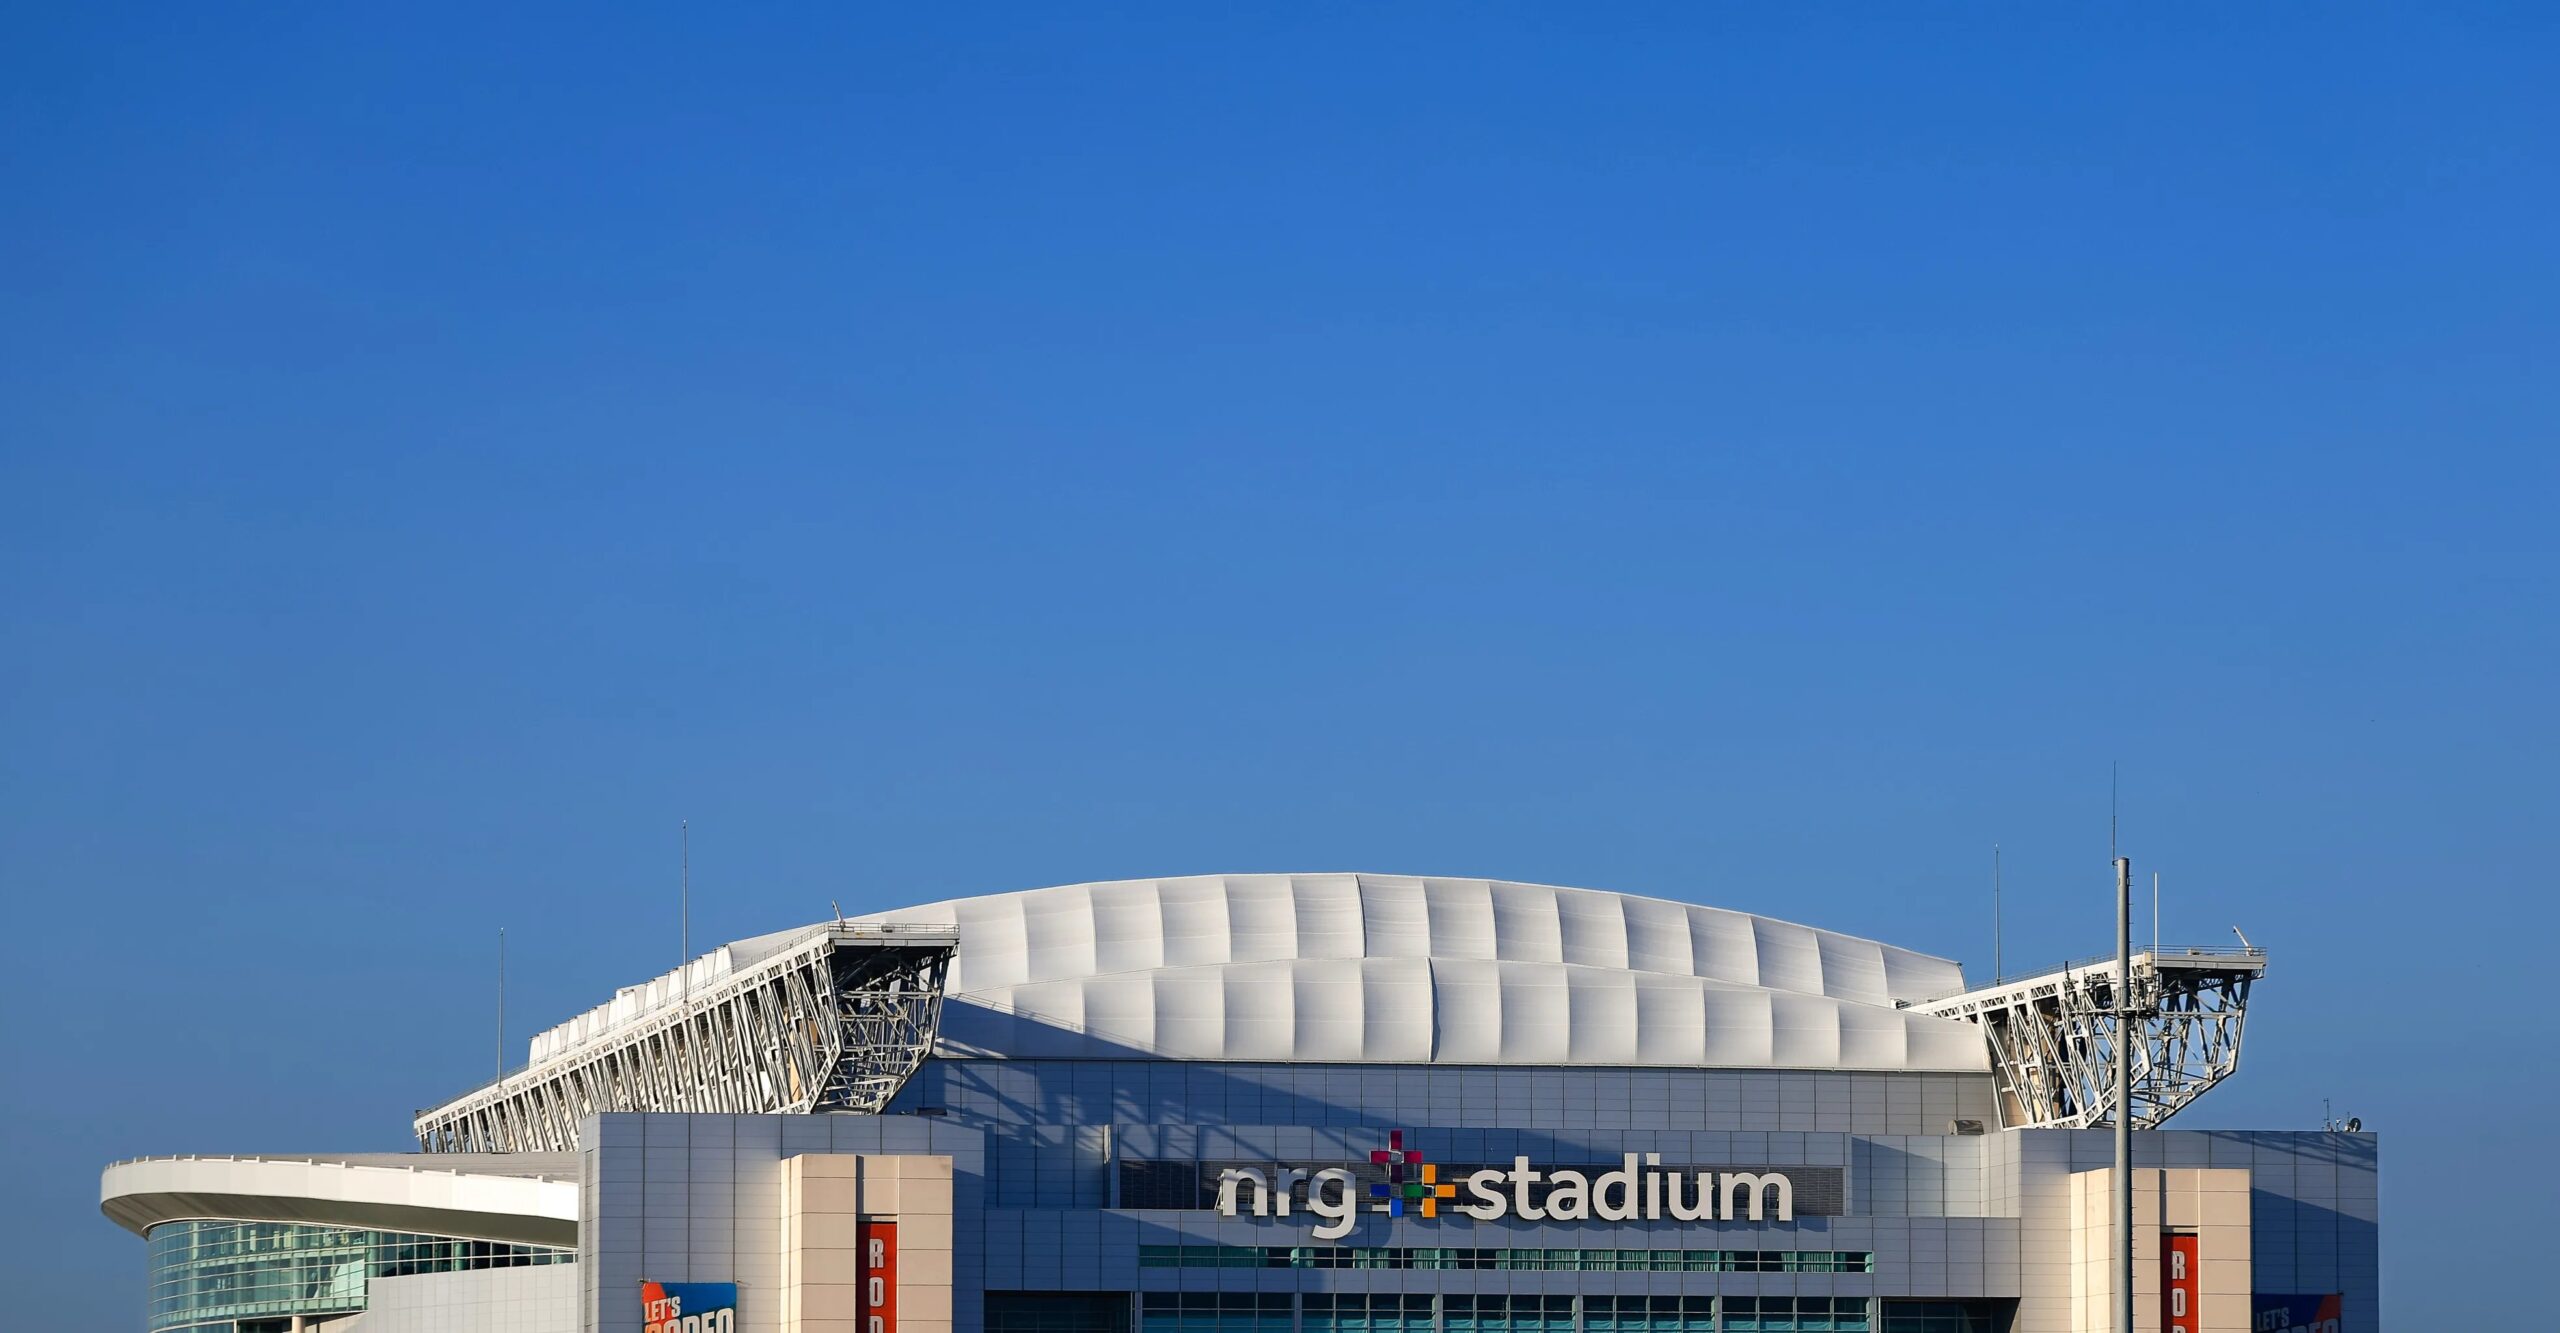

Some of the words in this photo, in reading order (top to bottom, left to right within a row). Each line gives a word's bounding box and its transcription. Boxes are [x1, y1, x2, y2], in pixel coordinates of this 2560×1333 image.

[1221, 1167, 1357, 1239] nrg
[1466, 1152, 1793, 1222] stadium
[644, 1295, 681, 1323] LET'S
[2172, 1251, 2186, 1333] RO
[2256, 1306, 2290, 1332] LET'S
